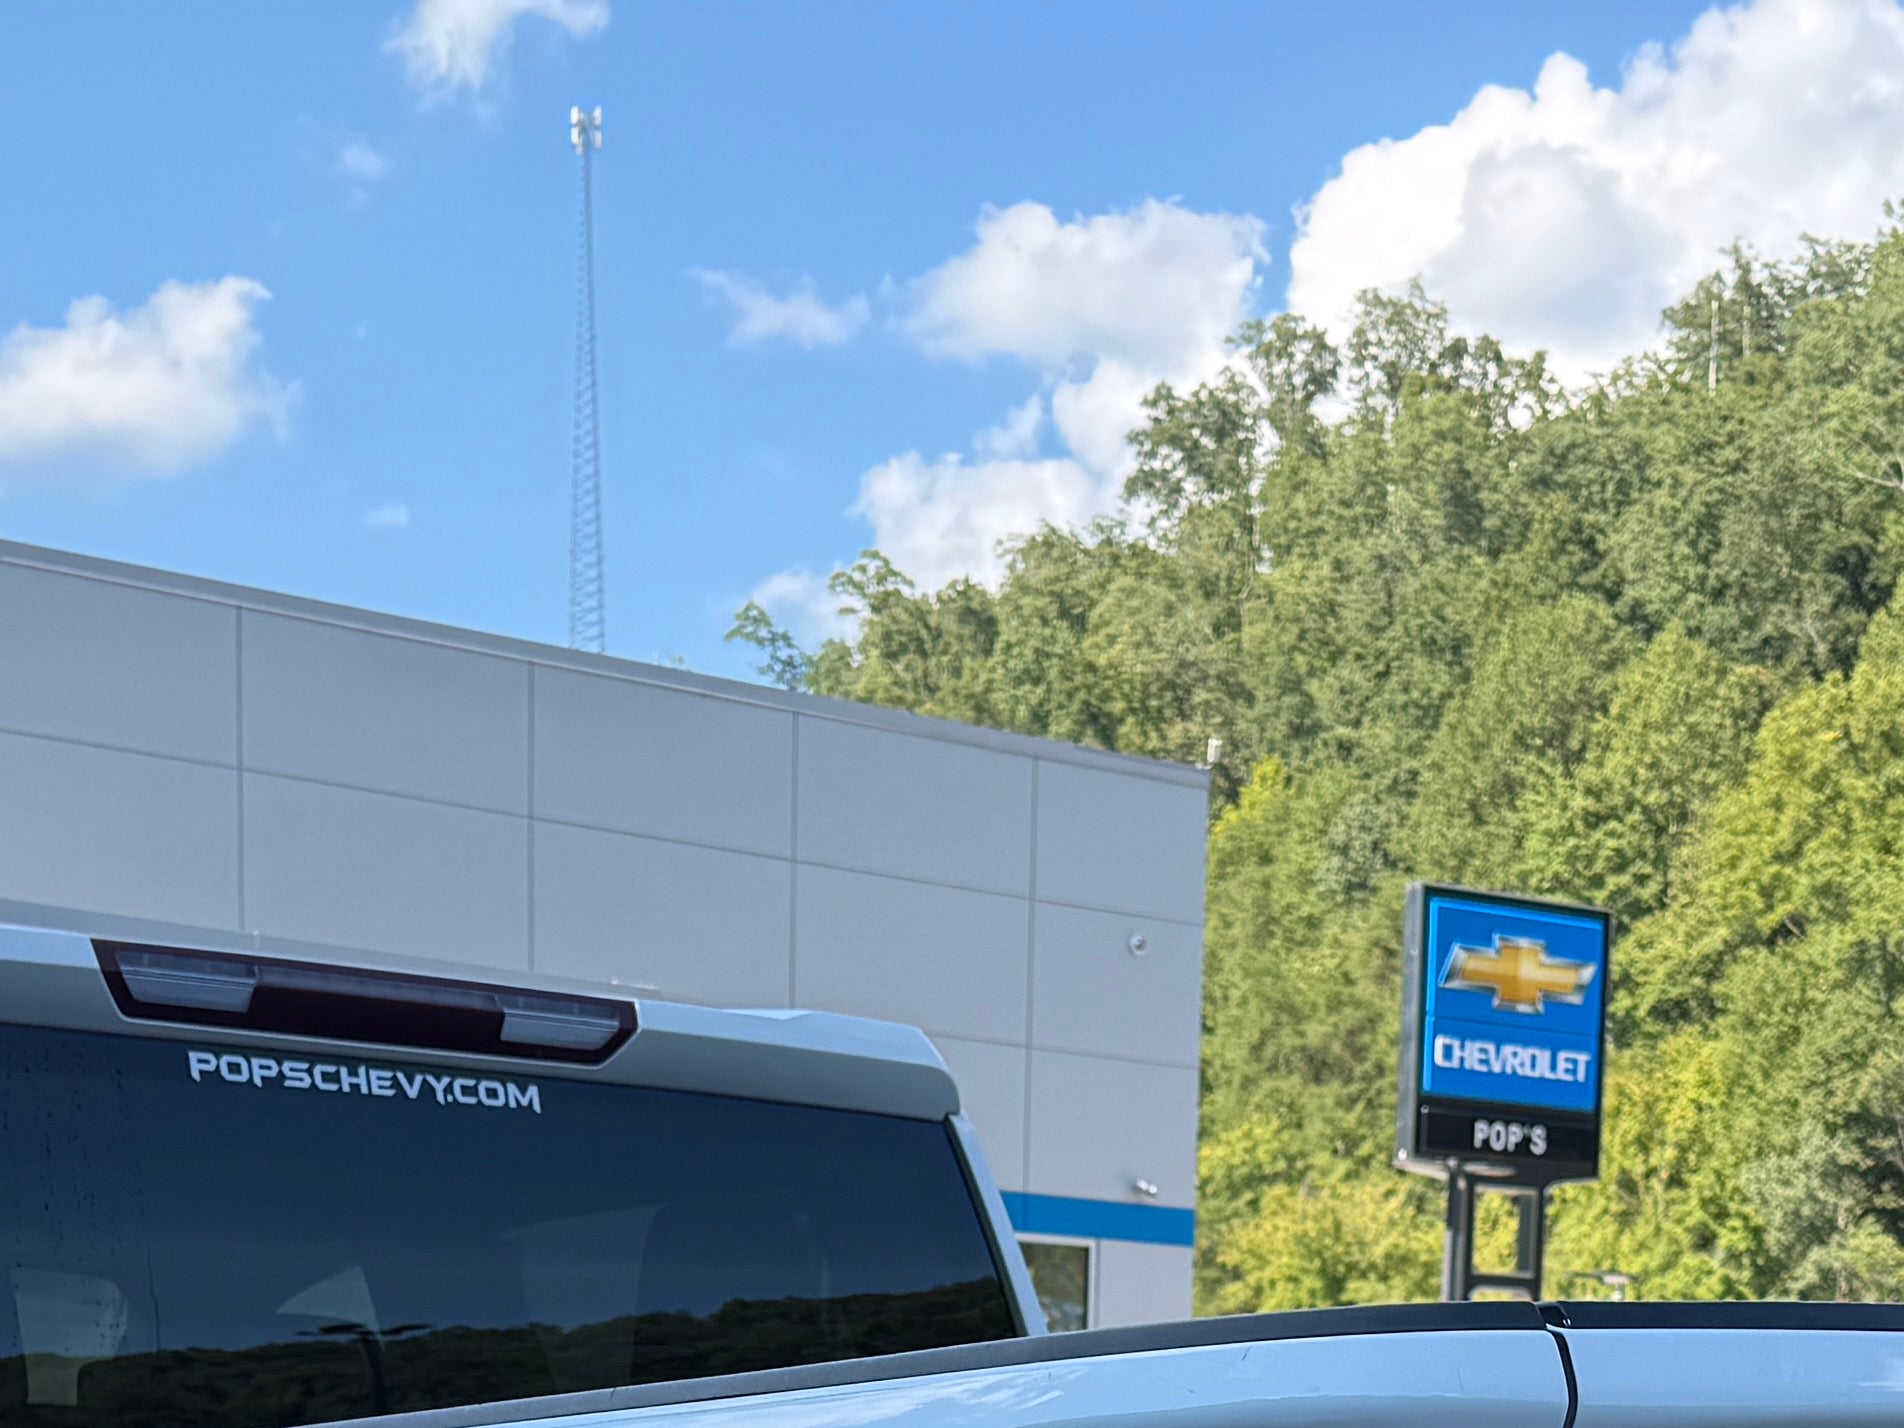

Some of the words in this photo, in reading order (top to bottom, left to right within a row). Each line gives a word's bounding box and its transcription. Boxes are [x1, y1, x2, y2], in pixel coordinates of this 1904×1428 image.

[187, 1049, 542, 1115] POPSCHEVY.COM
[1433, 1034, 1591, 1083] CHEVROLET
[1472, 1119, 1548, 1156] POP'S
